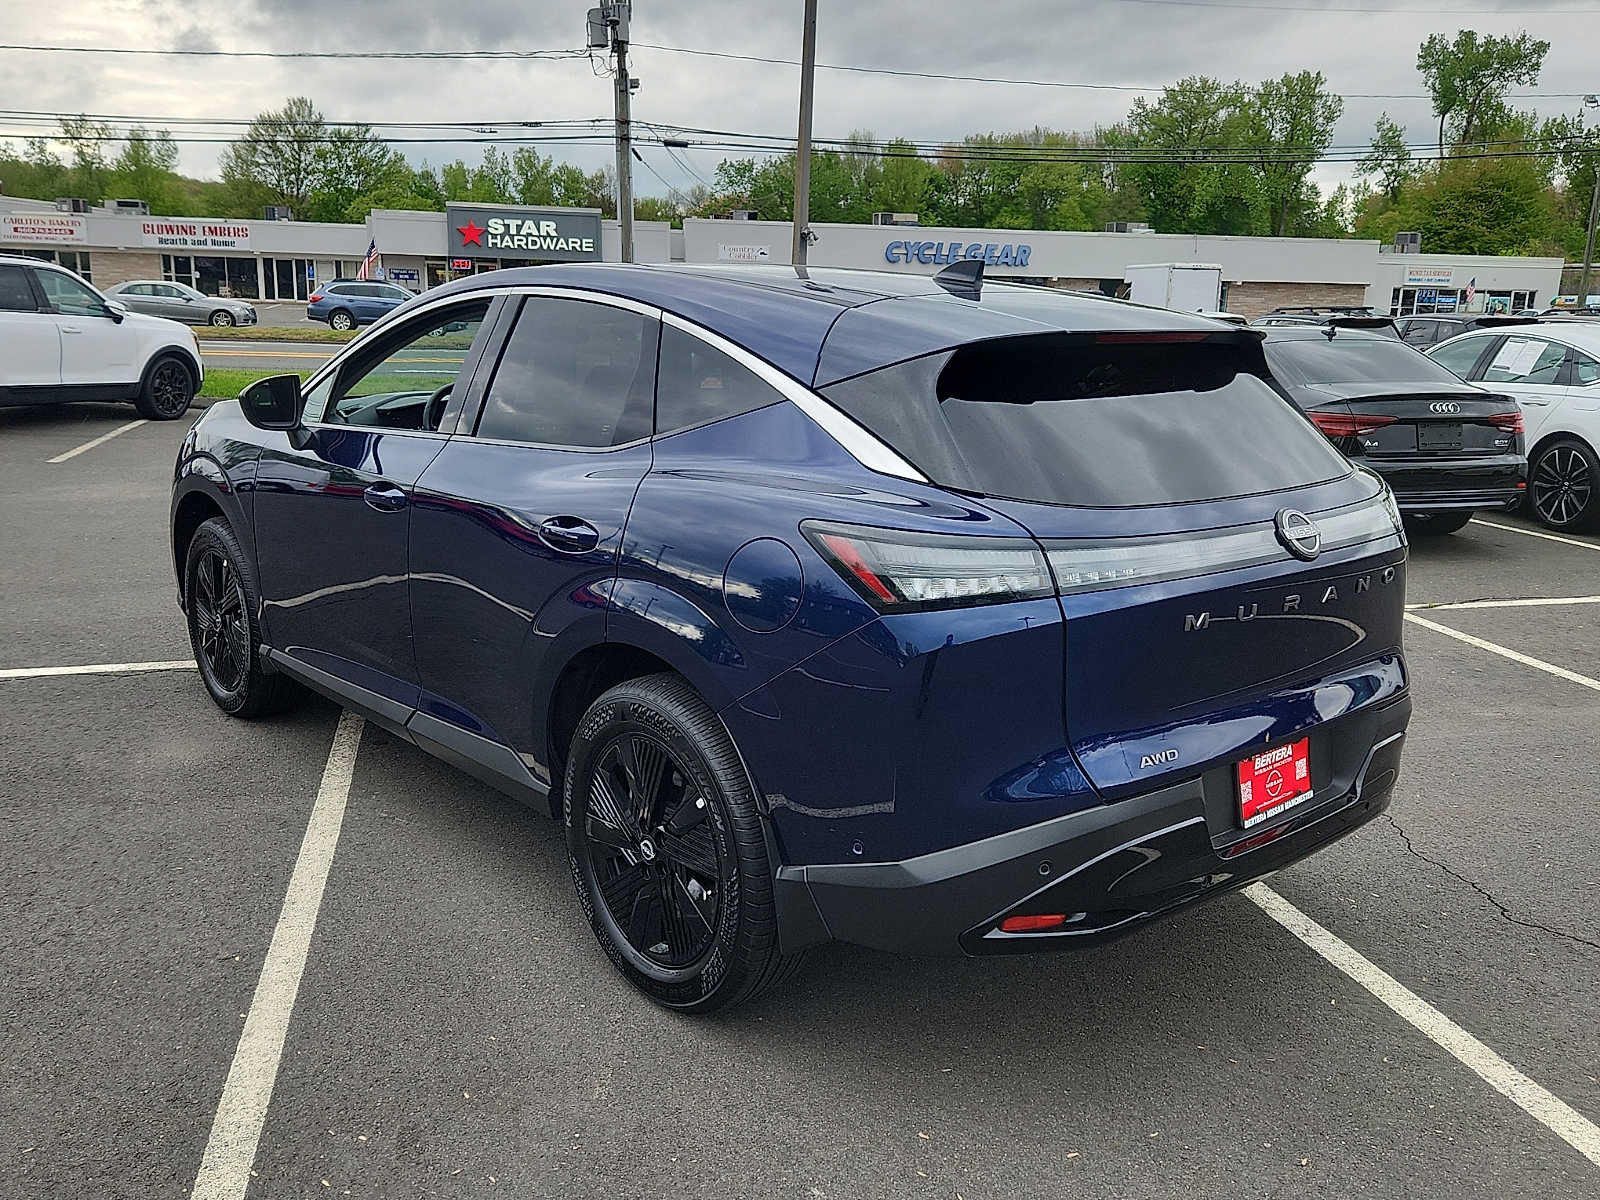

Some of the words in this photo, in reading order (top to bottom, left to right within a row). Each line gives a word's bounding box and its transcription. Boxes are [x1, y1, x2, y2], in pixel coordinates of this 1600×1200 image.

[49, 219, 81, 227] BAKERY
[142, 223, 197, 236] GLOWING
[202, 225, 249, 238] EMBERS
[487, 218, 558, 236] STAR
[158, 236, 188, 246] Hearth
[191, 238, 208, 247] and
[487, 234, 594, 252] HARDWARE
[885, 240, 963, 264] CYCLE
[965, 242, 1032, 267] GEAR
[1418, 288, 1436, 298] OPEN
[1184, 567, 1396, 632] MURANO
[1139, 749, 1179, 769] AWD
[1254, 744, 1293, 770] BERTERA
[1244, 812, 1267, 829] BERTERA
[1267, 803, 1285, 819] NISSAN
[1285, 790, 1314, 811] MANCHESTER
